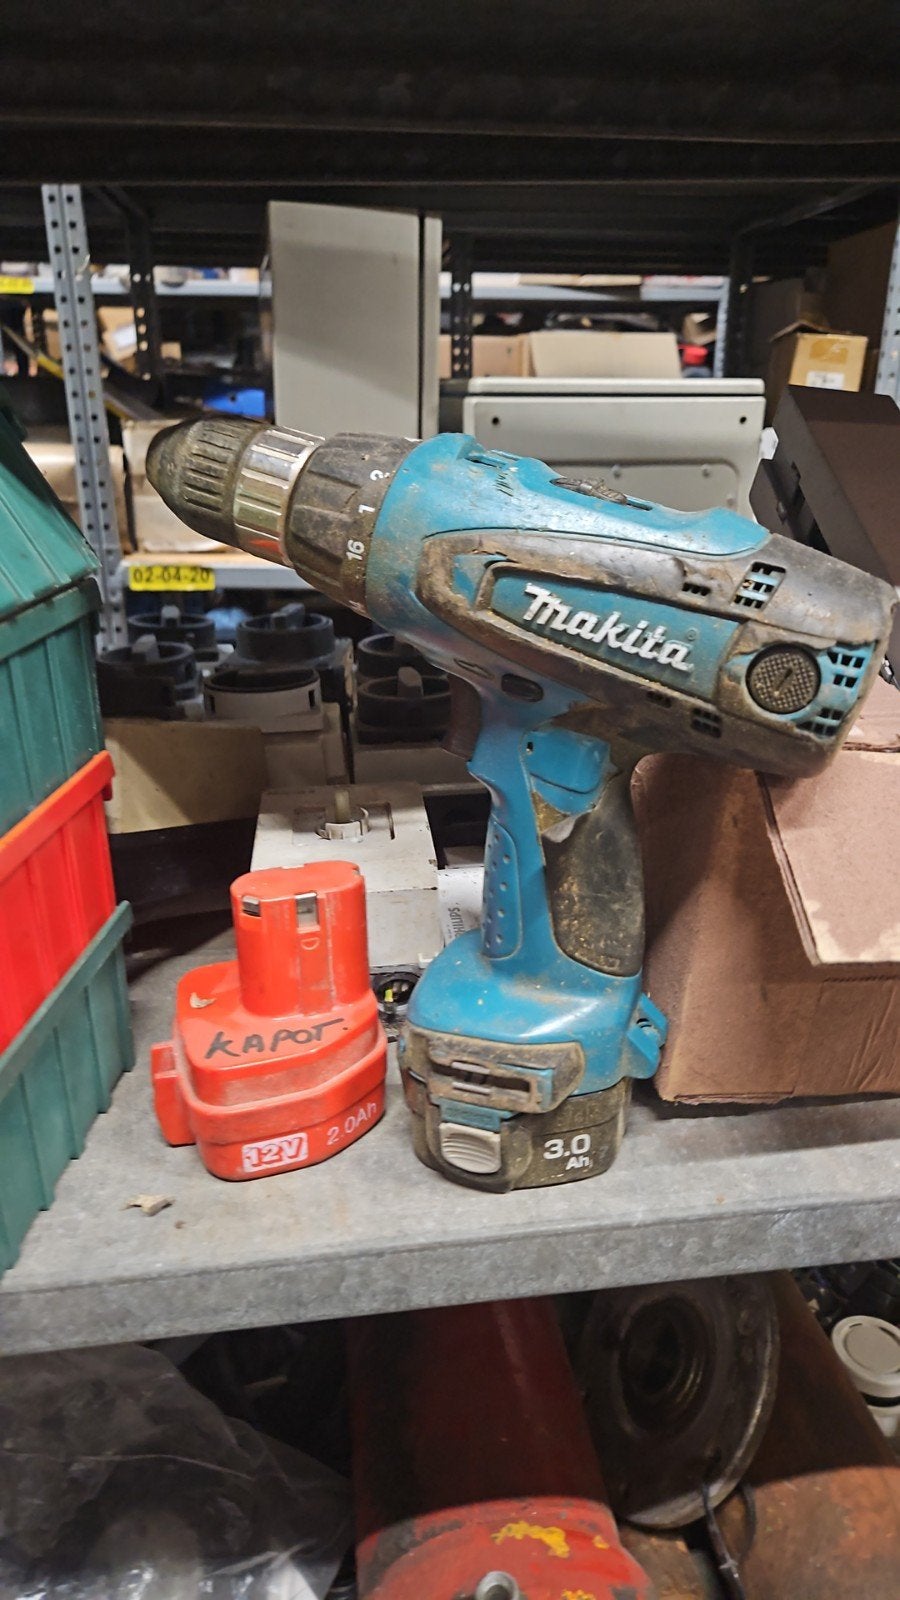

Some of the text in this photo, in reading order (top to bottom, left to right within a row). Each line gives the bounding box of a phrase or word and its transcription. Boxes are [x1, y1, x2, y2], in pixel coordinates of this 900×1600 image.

[358, 504, 375, 514] 1
[346, 539, 365, 560] 16
[522, 582, 695, 673] Makita
[244, 1135, 304, 1168] 12V
[543, 1133, 591, 1160] 3.0
[565, 1155, 590, 1171] Ah
